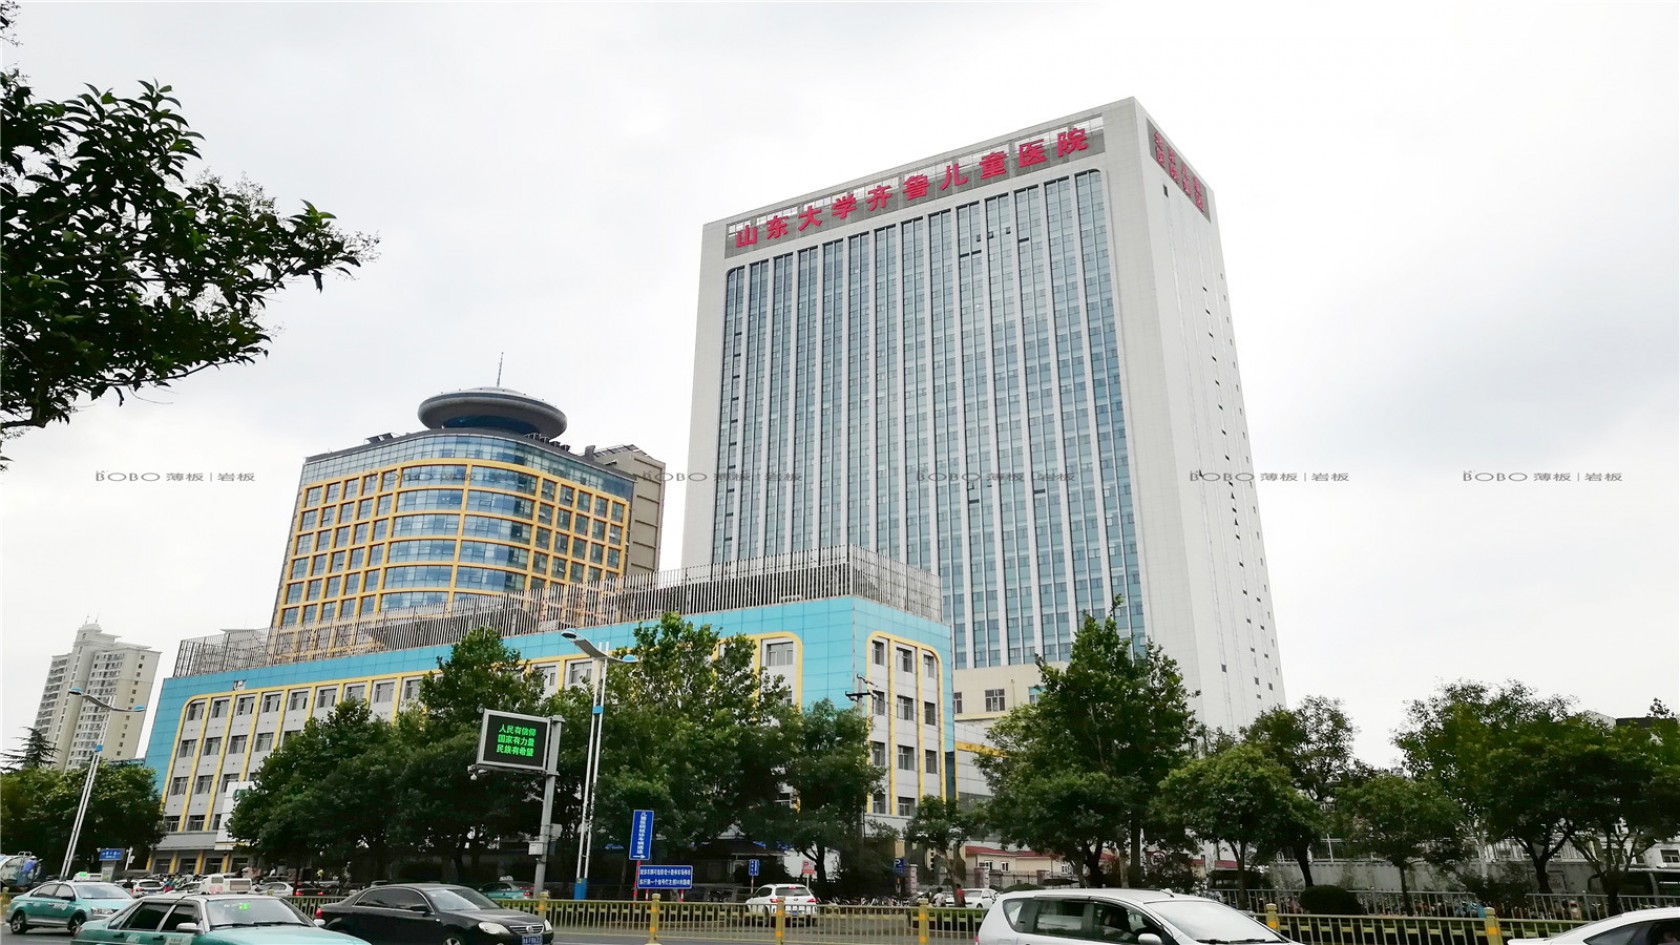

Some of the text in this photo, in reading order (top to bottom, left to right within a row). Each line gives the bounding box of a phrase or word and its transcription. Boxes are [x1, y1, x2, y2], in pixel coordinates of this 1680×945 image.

[736, 127, 1089, 248] 山东大学齐鲁儿童医院
[499, 724, 536, 736] 人民有信仰
[498, 735, 535, 746] 国家有力量
[496, 745, 534, 756] 民族有希望
